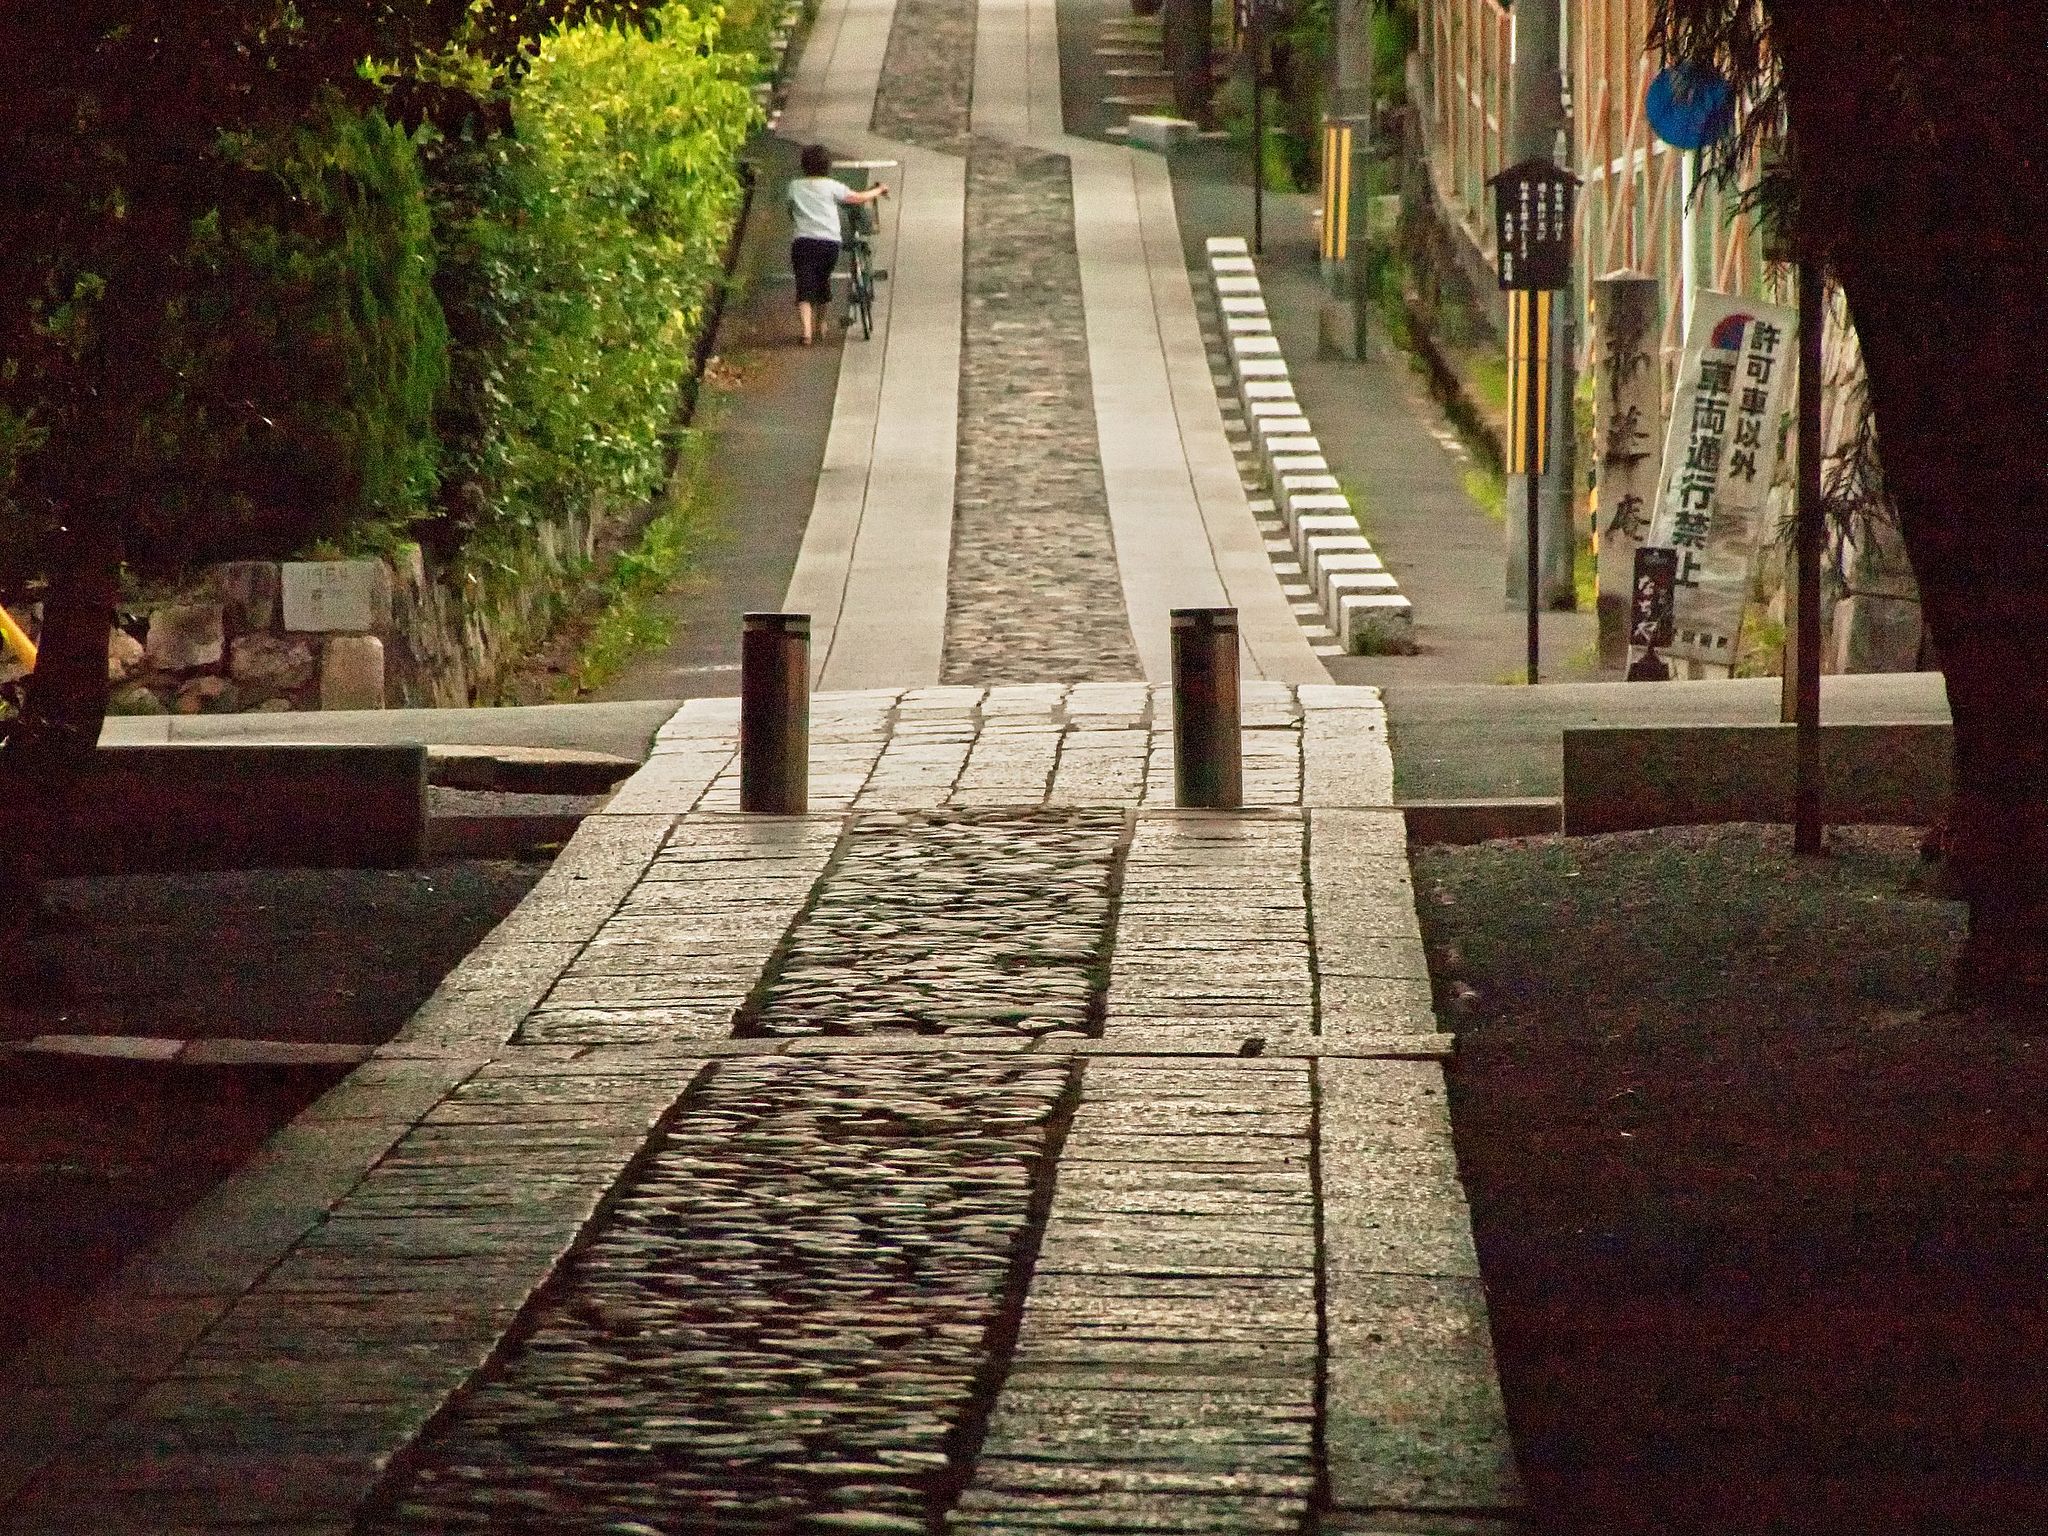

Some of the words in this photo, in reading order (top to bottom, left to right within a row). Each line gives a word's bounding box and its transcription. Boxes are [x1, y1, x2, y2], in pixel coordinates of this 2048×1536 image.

[1672, 359, 1736, 588] 車両通行禁止
[1728, 320, 1781, 483] 許可車以外
